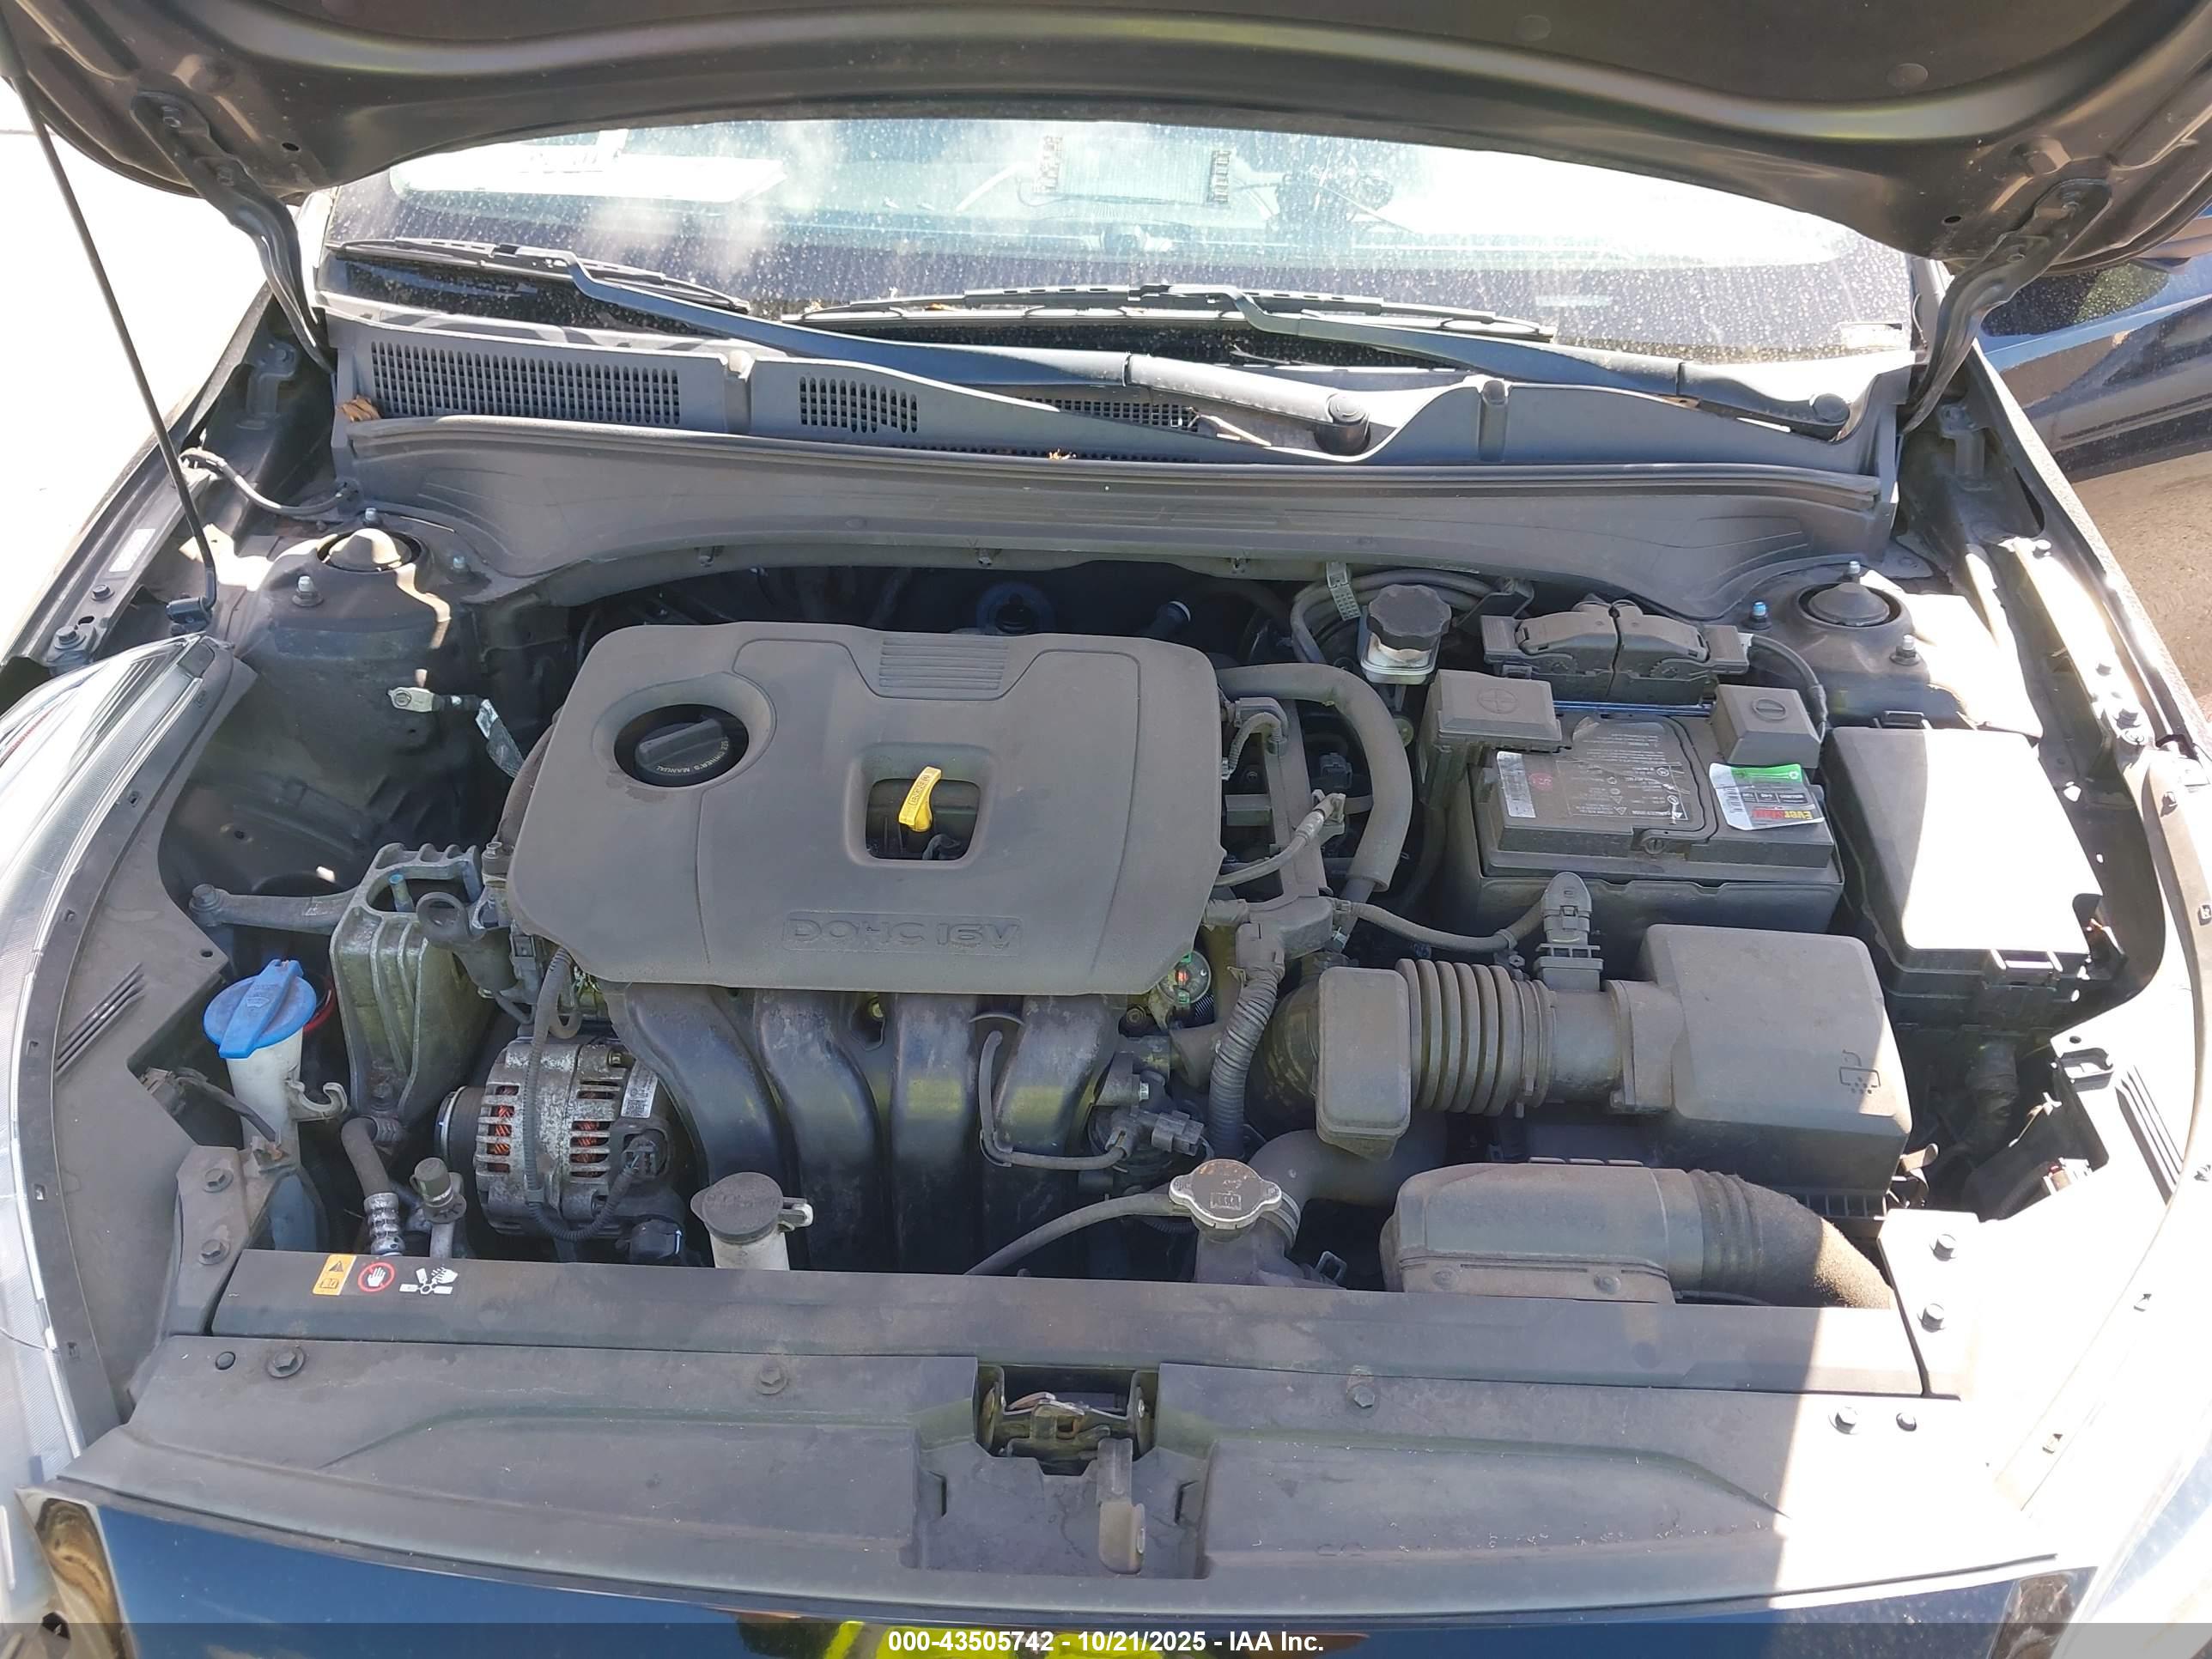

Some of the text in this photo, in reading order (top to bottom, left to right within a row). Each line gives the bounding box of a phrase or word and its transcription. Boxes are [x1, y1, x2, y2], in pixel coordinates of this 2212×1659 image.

[655, 765, 690, 774] MANUAL
[693, 750, 726, 770] OWNER'S
[787, 917, 1020, 949] DOHC 16V
